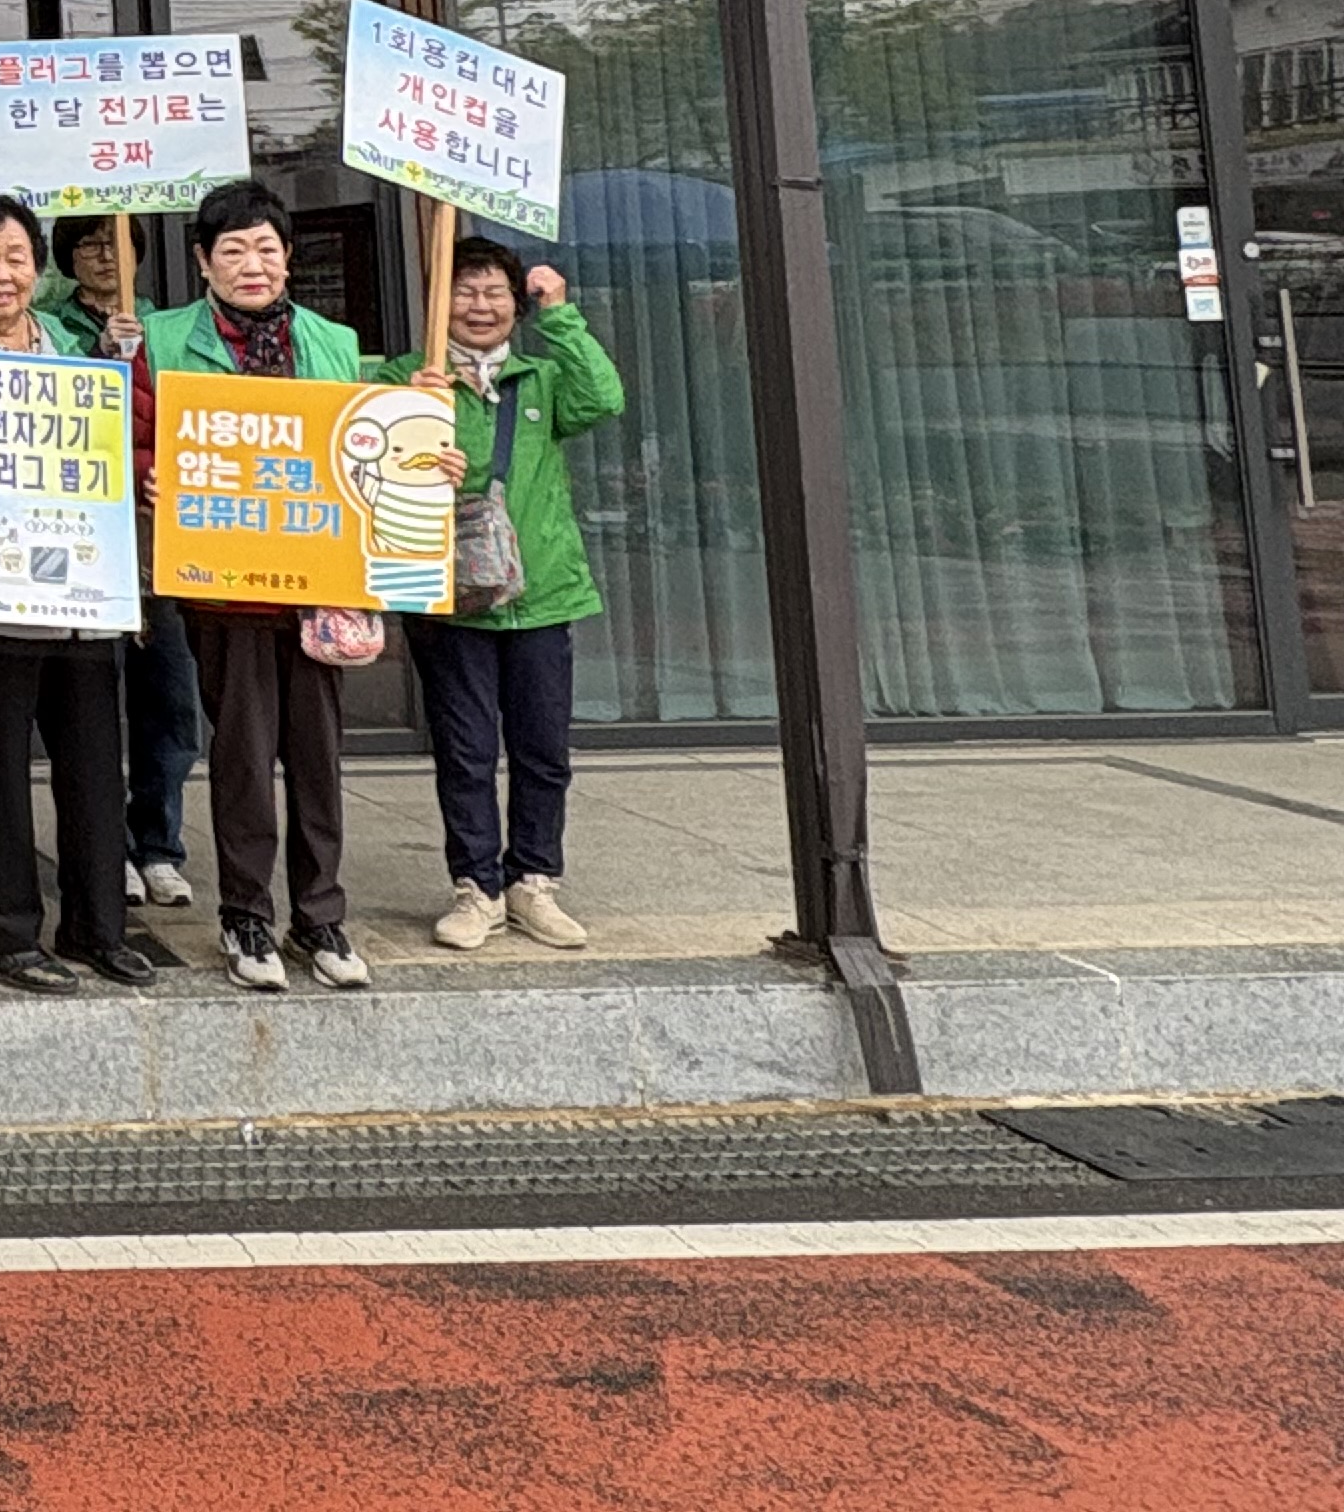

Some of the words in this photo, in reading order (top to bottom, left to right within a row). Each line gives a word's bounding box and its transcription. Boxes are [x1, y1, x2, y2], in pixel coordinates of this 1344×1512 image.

[139, 48, 234, 80] 뽑으면
[372, 21, 480, 83] 1회용컵
[492, 64, 548, 109] 대신
[8, 98, 40, 130] 한
[53, 97, 83, 128] 달
[98, 92, 226, 126] 전기료는
[396, 72, 520, 140] 개인컵을
[89, 139, 154, 172] 공짜
[378, 107, 532, 189] 사용합니다
[17, 191, 50, 209] MU
[72, 374, 121, 411] 않는
[176, 409, 304, 452] 사용하지
[350, 432, 379, 450] OFF
[59, 456, 109, 496] 뽑기
[176, 451, 242, 491] 않는
[252, 455, 324, 495] 조명,
[176, 493, 269, 532] 컴퓨터
[280, 501, 342, 539] 끄기
